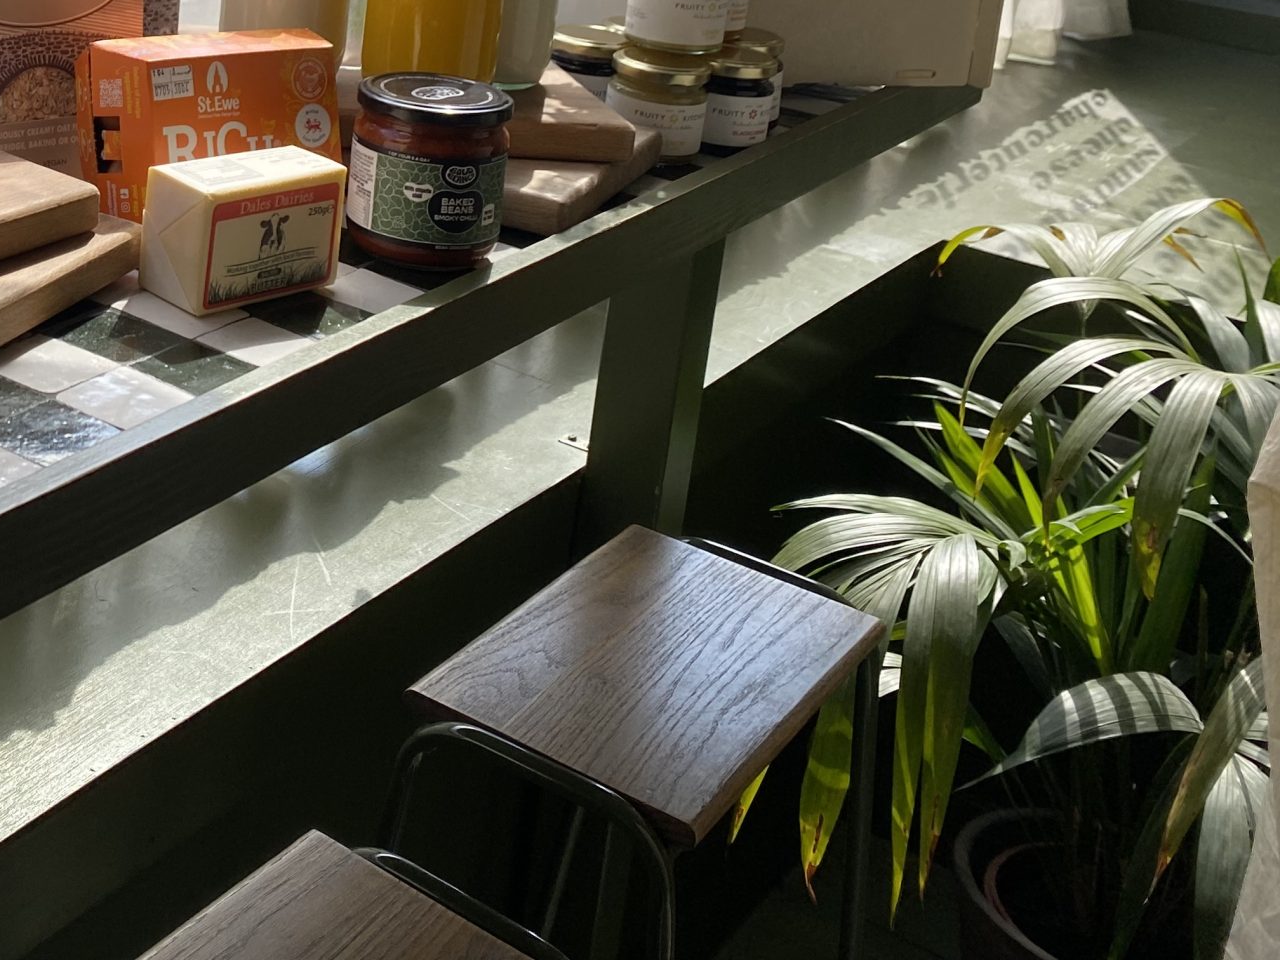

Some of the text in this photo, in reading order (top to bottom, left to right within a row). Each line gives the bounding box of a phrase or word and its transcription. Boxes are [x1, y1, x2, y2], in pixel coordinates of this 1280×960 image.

[675, 2, 706, 12] FRUITY
[634, 109, 666, 120] FRUITY
[712, 107, 746, 117] FRUITY
[240, 190, 315, 215] Dales Dairies
[441, 197, 475, 206] BAKED
[440, 205, 474, 214] BEANS
[434, 214, 459, 222] SMOKY
